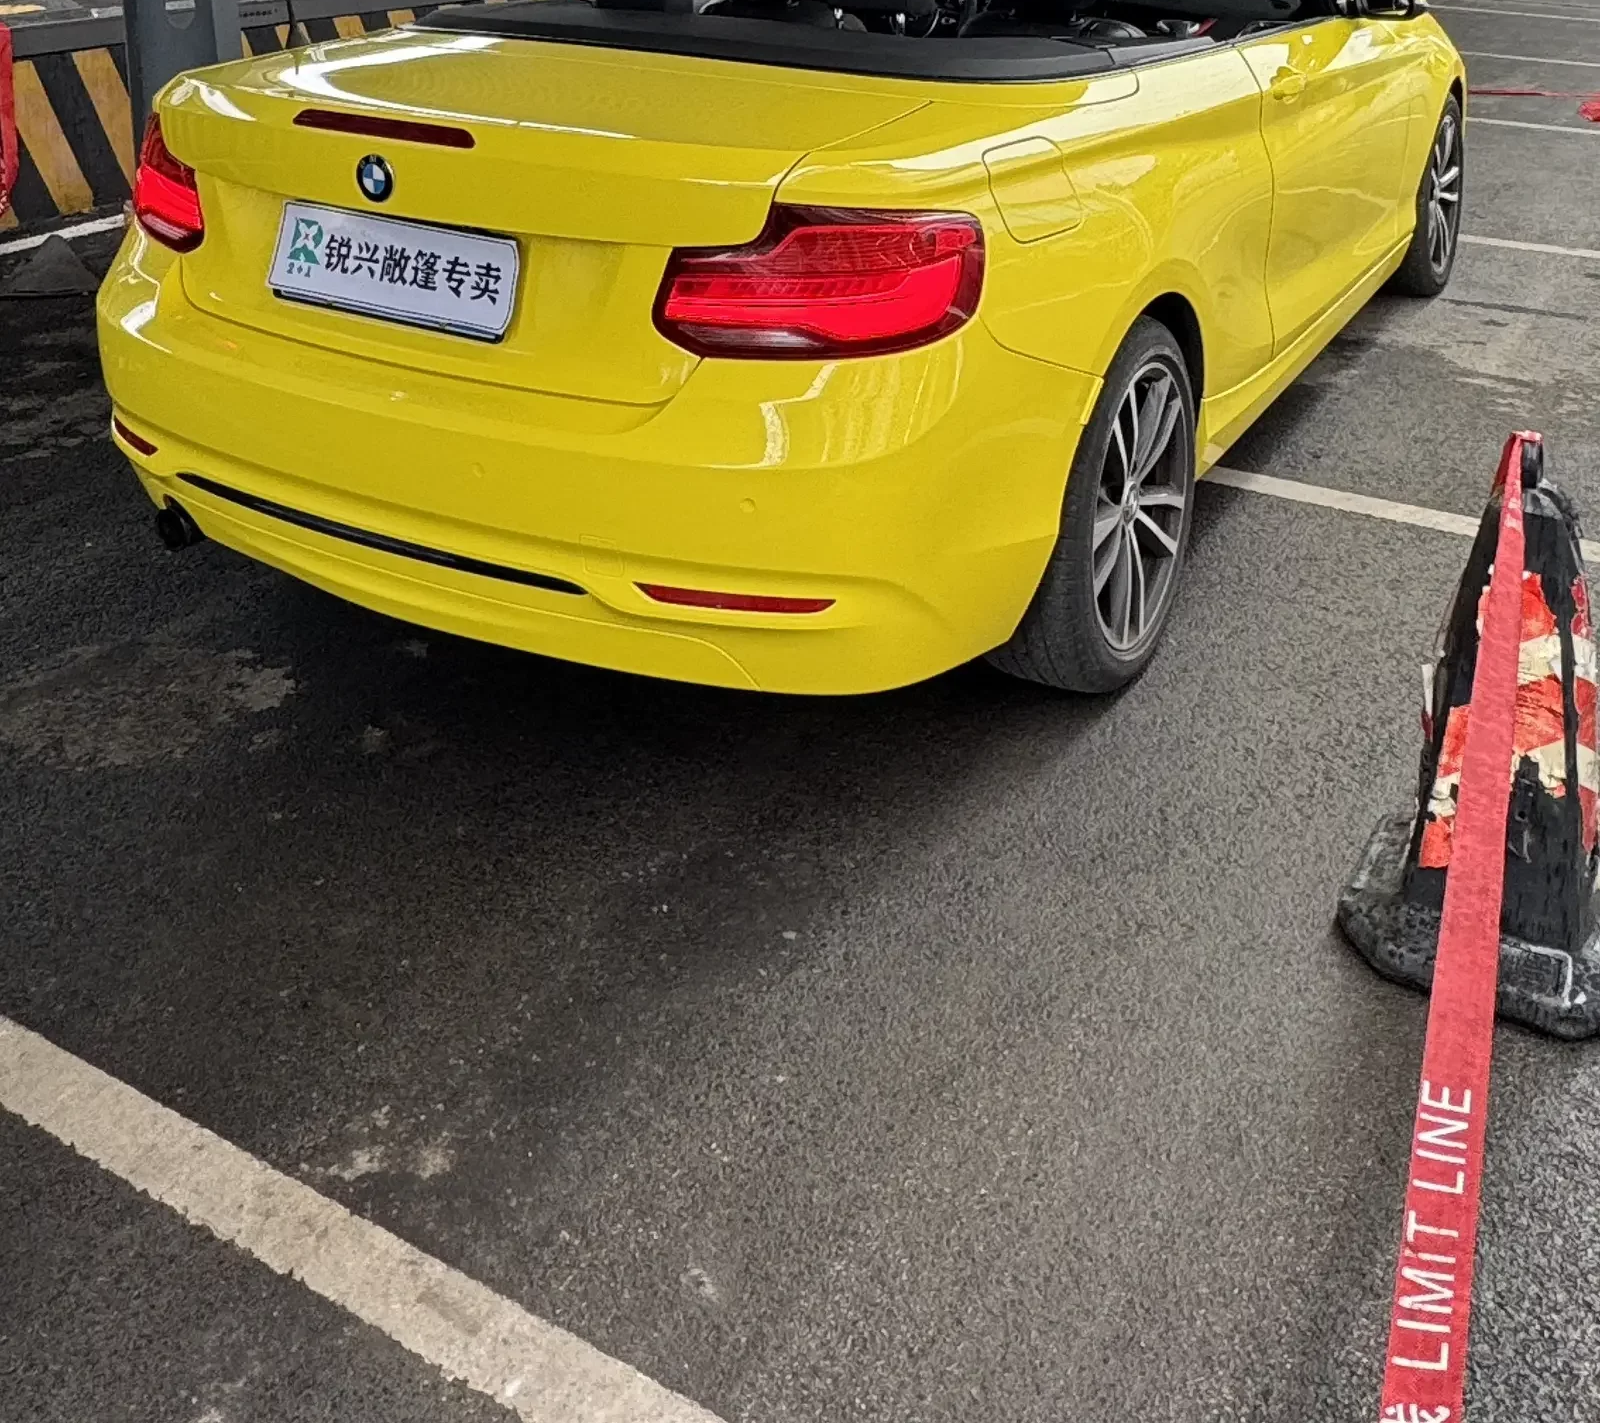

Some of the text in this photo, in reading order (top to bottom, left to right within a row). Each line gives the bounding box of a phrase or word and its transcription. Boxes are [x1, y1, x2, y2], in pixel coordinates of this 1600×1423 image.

[324, 234, 502, 306] 锐兴敞篷专卖
[1413, 1079, 1472, 1195] LINE
[1392, 1210, 1459, 1371] LIMIT
